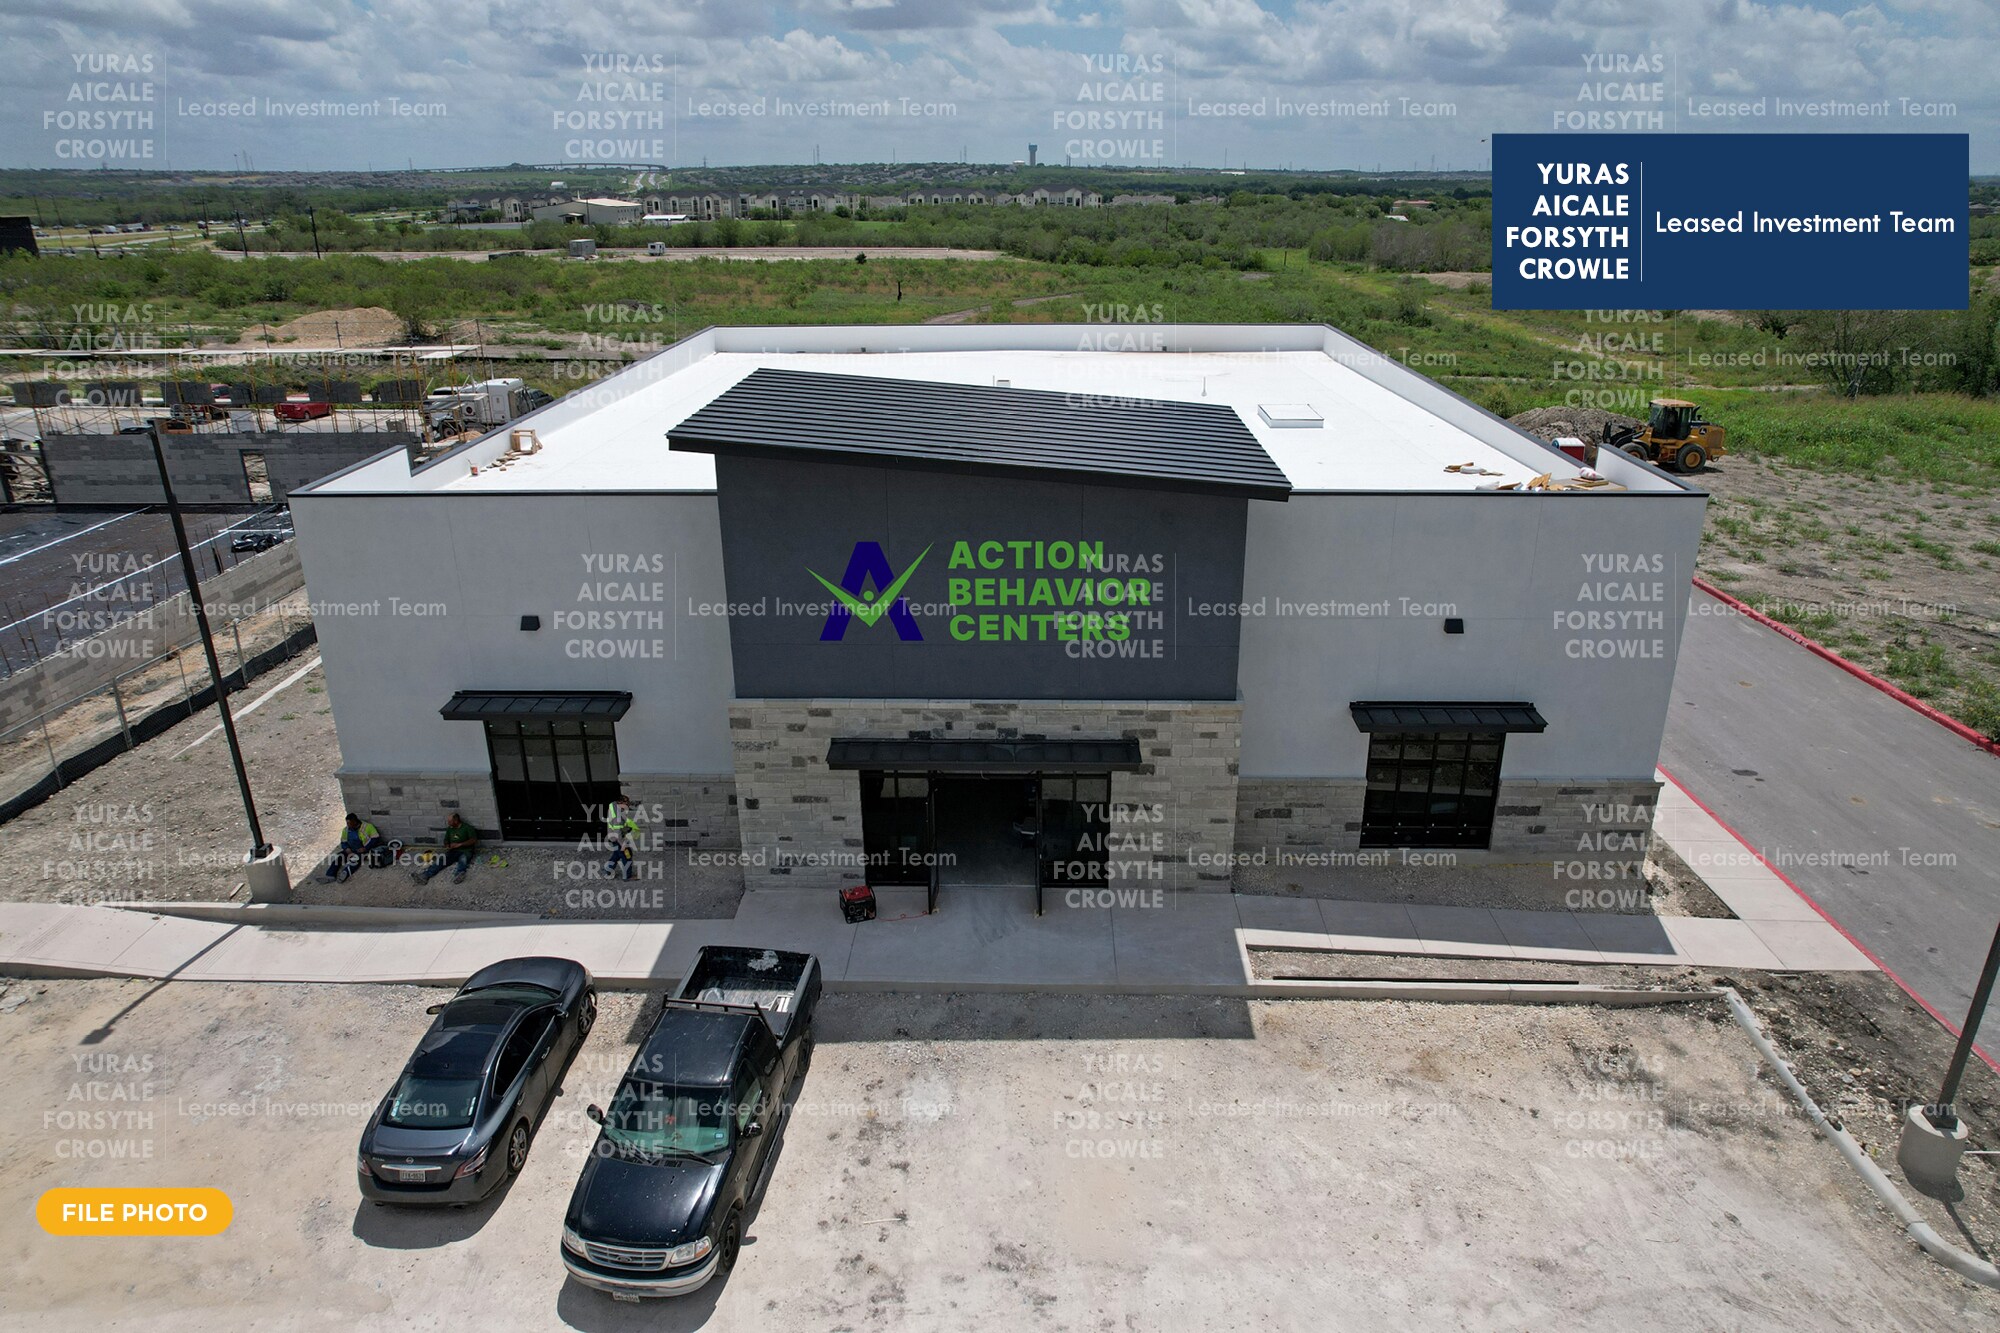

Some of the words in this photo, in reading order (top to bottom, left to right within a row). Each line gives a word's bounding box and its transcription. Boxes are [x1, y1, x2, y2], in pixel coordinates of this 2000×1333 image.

[948, 541, 1104, 569] ACTION
[948, 578, 1151, 606] BEHAVIOR
[949, 614, 1131, 642] CENTERS
